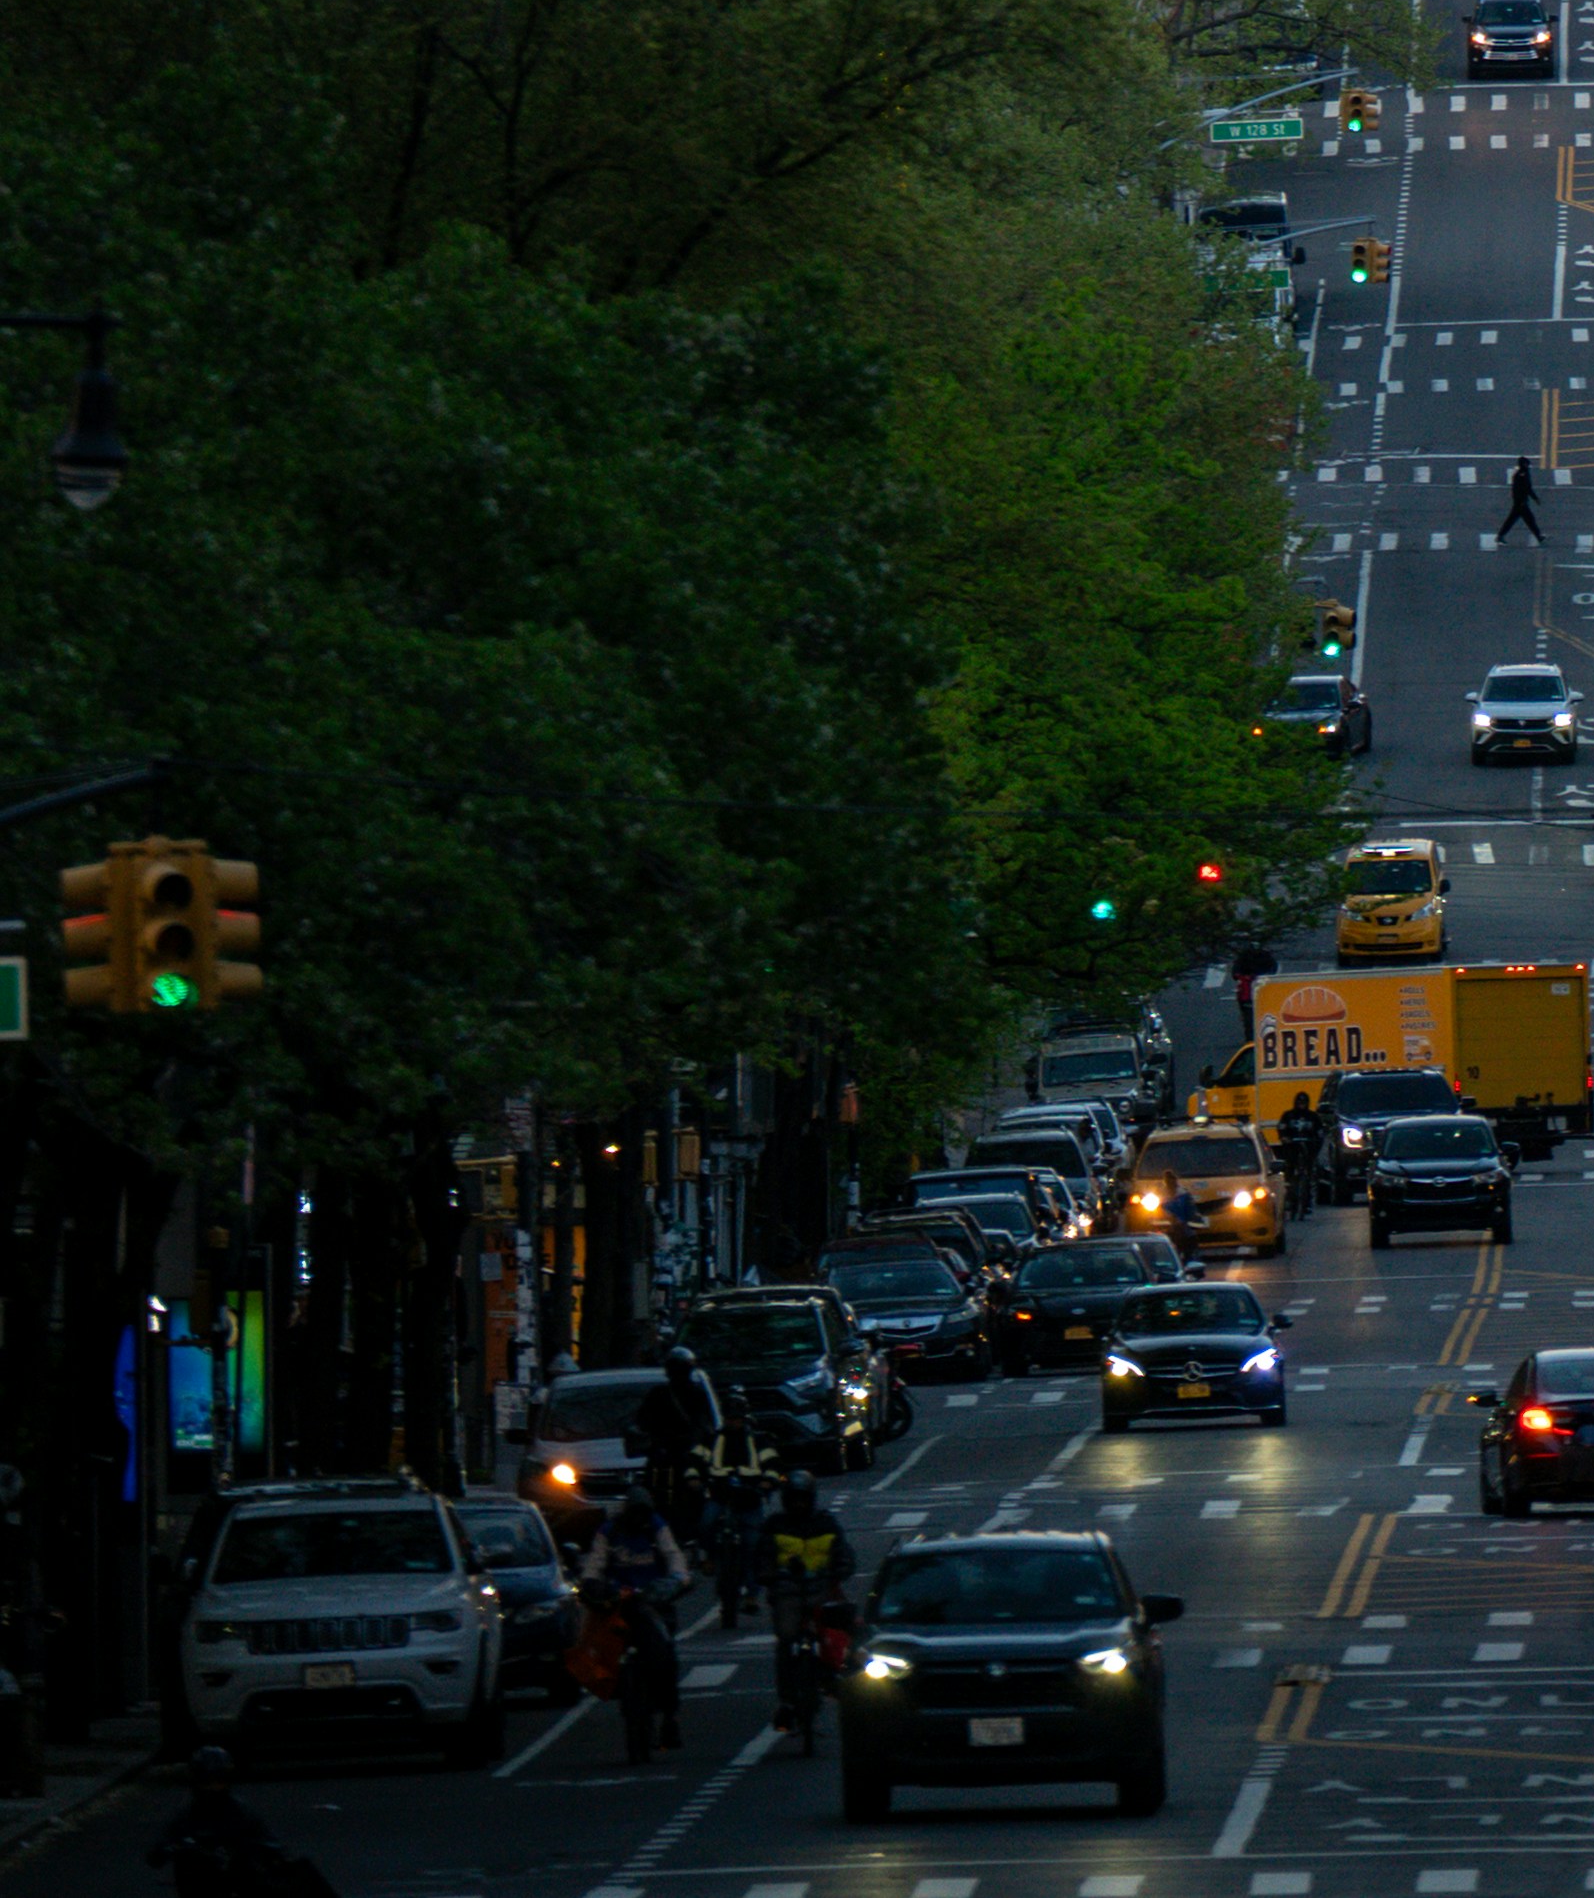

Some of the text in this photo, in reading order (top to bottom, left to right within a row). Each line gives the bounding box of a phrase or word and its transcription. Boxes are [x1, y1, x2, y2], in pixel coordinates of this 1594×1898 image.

[1229, 123, 1285, 136] W 128 St
[1466, 1065, 1480, 1080] 10
